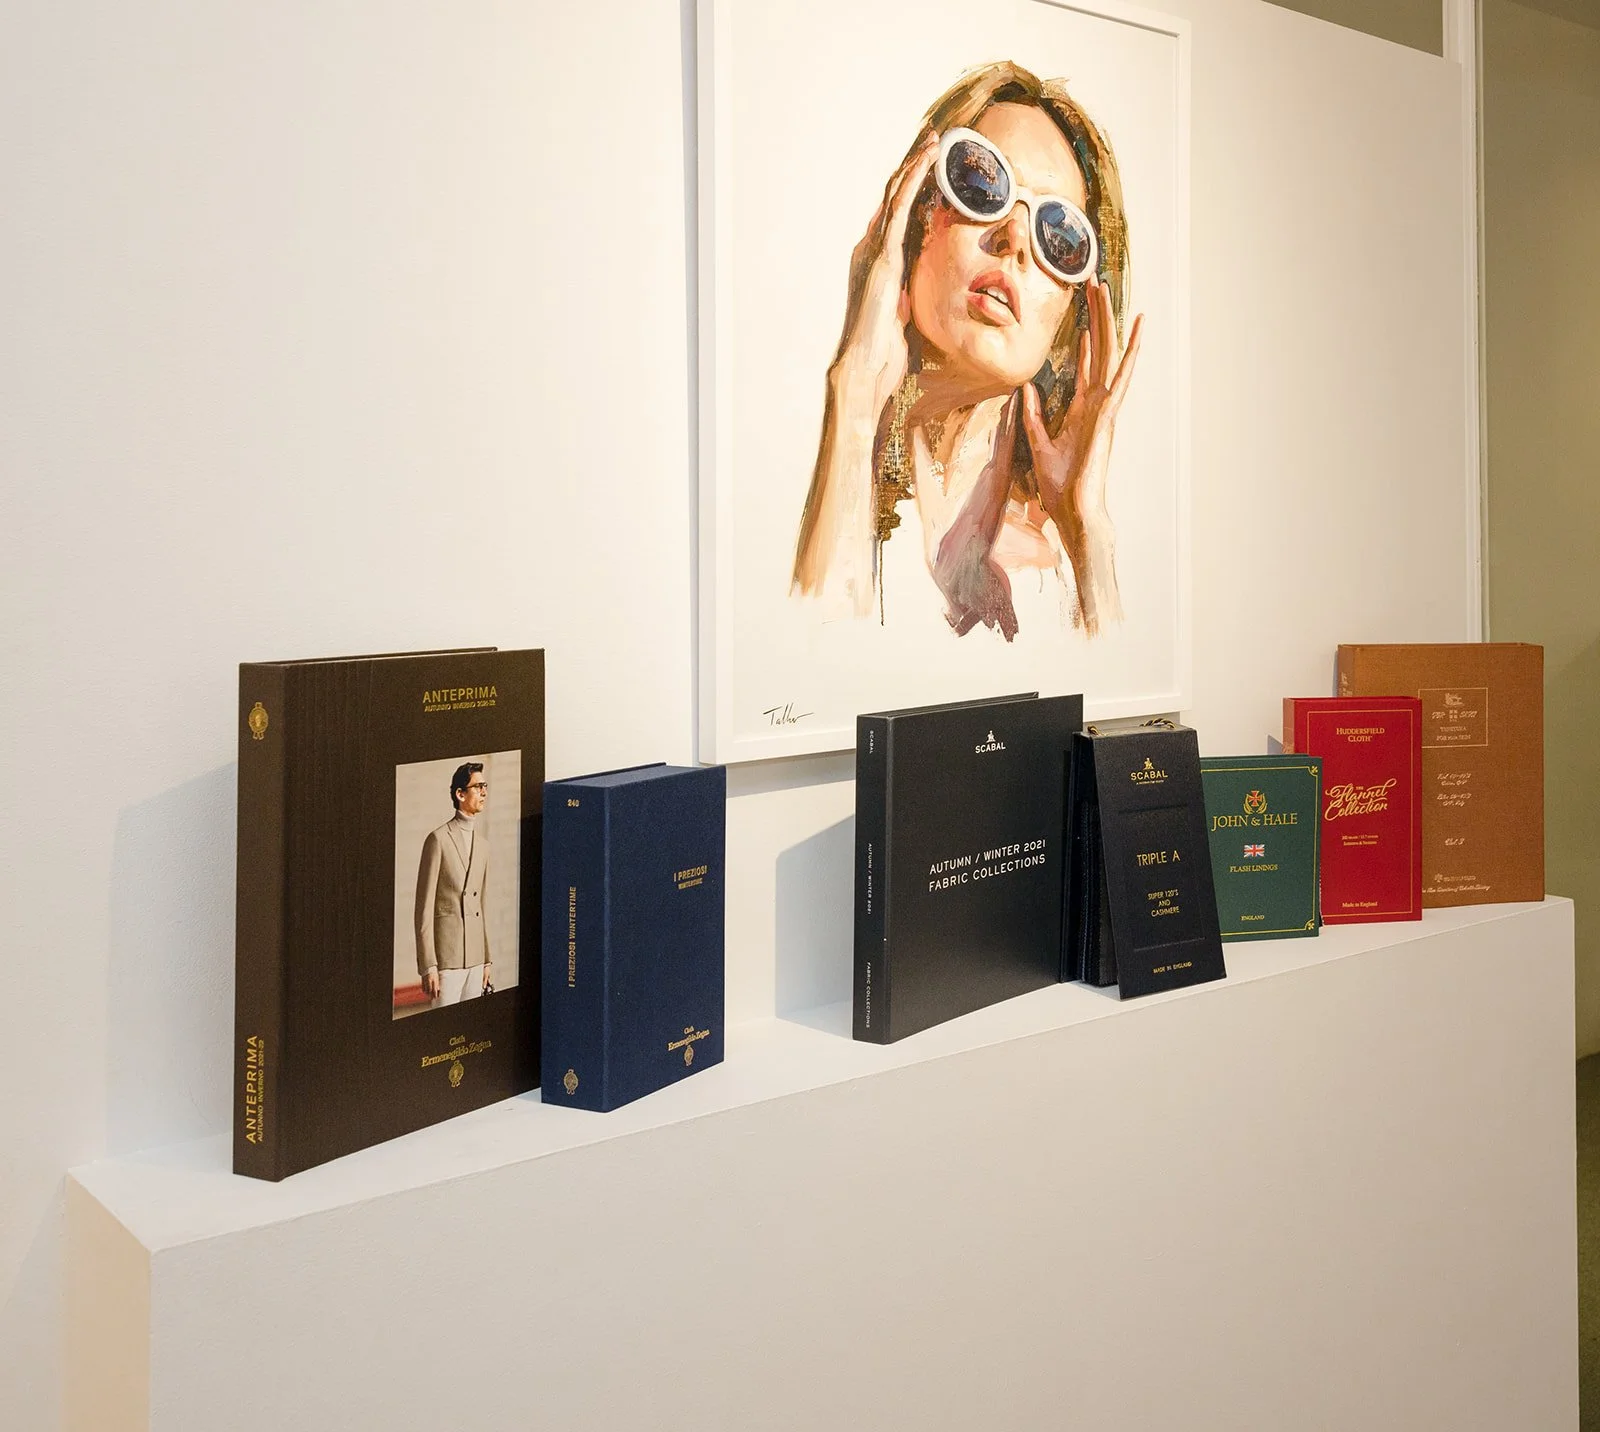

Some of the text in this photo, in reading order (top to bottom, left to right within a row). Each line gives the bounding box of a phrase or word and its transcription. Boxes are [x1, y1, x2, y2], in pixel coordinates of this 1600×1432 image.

[422, 686, 498, 704] ANTEPRIMA
[1336, 727, 1385, 736] HUDDERSFIELD
[975, 742, 1007, 754] SCABAL
[1130, 770, 1169, 781] SCABAL
[1324, 778, 1397, 803] Flannel
[1324, 797, 1388, 821] Collection
[1211, 812, 1298, 832] JOHN & HALE
[929, 839, 1046, 876] AUTUMN / WINTER 2021
[1136, 850, 1181, 867] TRIPLE A
[678, 864, 708, 881] PREZIOSI
[928, 853, 1046, 892] FABRIC COLLECTIONS
[1229, 863, 1279, 873] FLASH LININGS
[1147, 891, 1164, 901] SUPER
[1158, 899, 1171, 907] AND
[569, 886, 577, 939] WINTERTIME
[1151, 905, 1180, 917] CASHMERE
[568, 941, 576, 982] PREZIOSI
[1153, 966, 1166, 974] MADE
[1172, 961, 1193, 970] ENGLAND
[449, 1034, 466, 1046] Cloth
[421, 1040, 493, 1068] Ermenegildo Zegna
[245, 1035, 258, 1145] ANTEPRIMA
[257, 1069, 265, 1102] INVERNO
